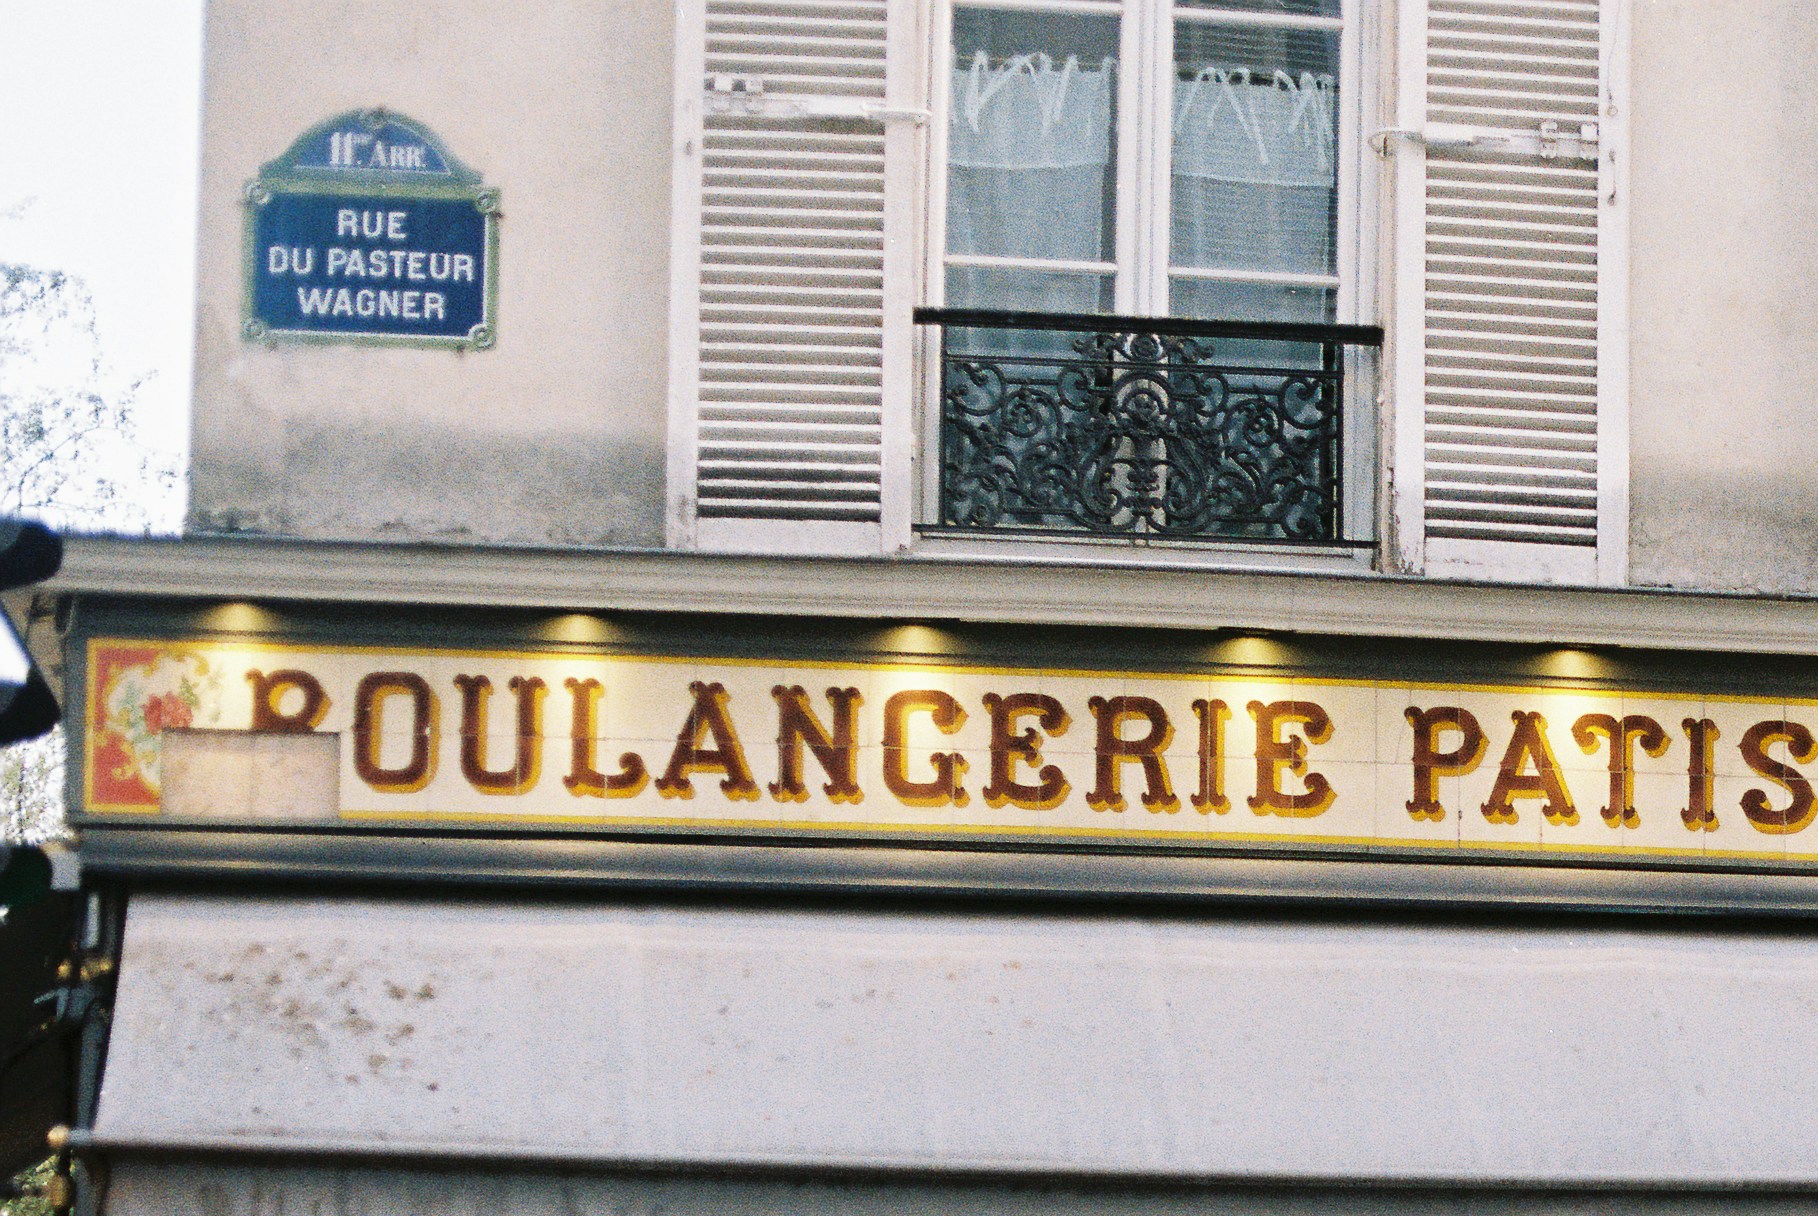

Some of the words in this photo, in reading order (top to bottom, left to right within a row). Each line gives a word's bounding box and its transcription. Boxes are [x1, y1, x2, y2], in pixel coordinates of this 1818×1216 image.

[337, 209, 407, 239] RUE
[268, 246, 312, 274] DU
[327, 249, 474, 282] PASTEUR
[297, 288, 445, 320] WAGNER
